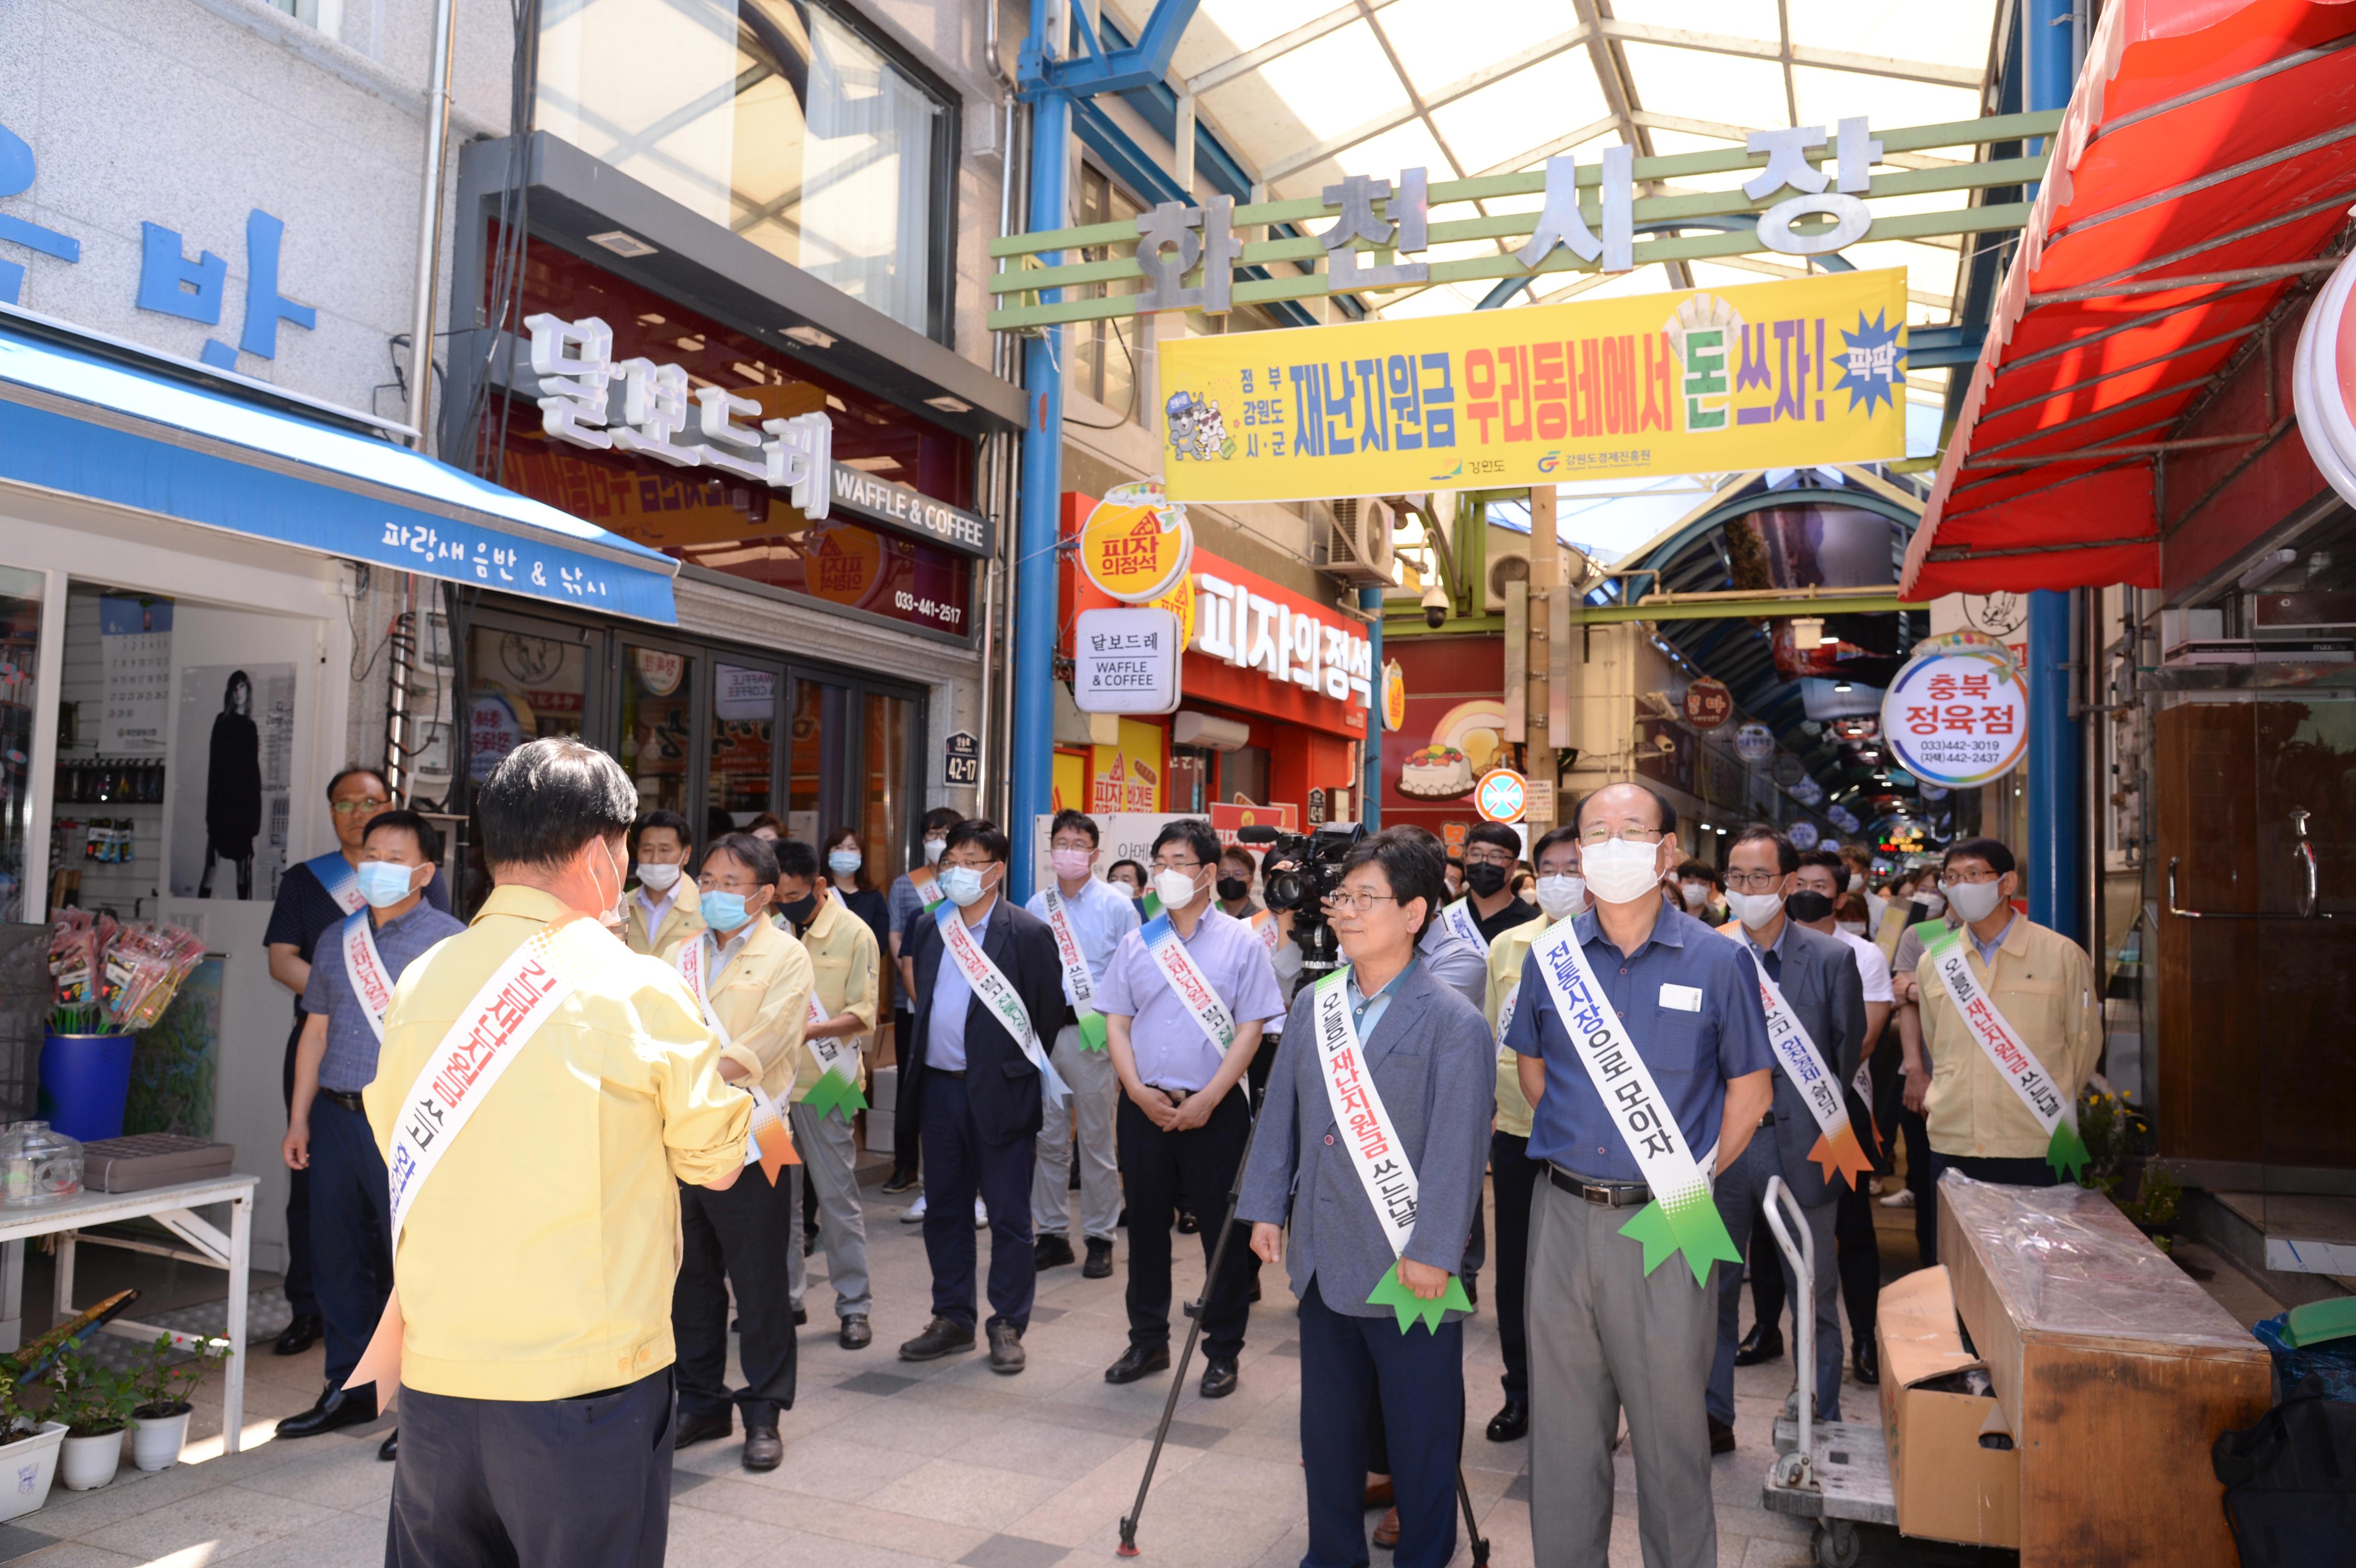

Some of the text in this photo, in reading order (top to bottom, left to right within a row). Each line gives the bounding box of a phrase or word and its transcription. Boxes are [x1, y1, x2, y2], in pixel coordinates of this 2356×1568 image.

[1134, 116, 1883, 315] 화천시장
[1847, 341, 1895, 382] 팍팍
[1289, 318, 1825, 457] 재난지원금 우리동네에서 돈 쓰자!
[1244, 399, 1284, 426] 강원도
[1468, 460, 1505, 474] 강원도
[1566, 449, 1651, 466] 강원도경제진흥원
[835, 469, 983, 547] WAFFLE & COFFEE
[382, 522, 606, 596] 파랑새 음반 & 낚시
[1102, 536, 1159, 557] 피자
[1102, 555, 1157, 576] 의정석
[895, 590, 961, 624] 033-441-2517
[1091, 632, 1158, 652] 달보드레
[1092, 674, 1154, 686] & COFFEE
[1096, 662, 1147, 673] WAFFLE
[1927, 674, 1991, 700] 충북
[1905, 705, 2013, 735] 정육점
[1920, 740, 2000, 751] 033)442-3019
[948, 757, 977, 781] 42-17
[1095, 781, 1154, 808] 피자 바게트
[1051, 910, 1079, 966] 재난지원금
[946, 920, 988, 981] 긴급재난지원금
[980, 975, 1004, 1000] 받고
[1160, 944, 1212, 1011] 긴급재난지원금
[1201, 1005, 1226, 1031] 받고
[432, 959, 557, 1109] 긴급재난지원금
[1322, 992, 1348, 1052] 오늘은
[1944, 958, 1975, 1002] 오늘은
[1965, 997, 2029, 1075] 재난지원금
[1546, 940, 1675, 1160] 전통시장으로 모이자
[1330, 1047, 1389, 1160] 재난지원금
[405, 1098, 444, 1152] 쓰고
